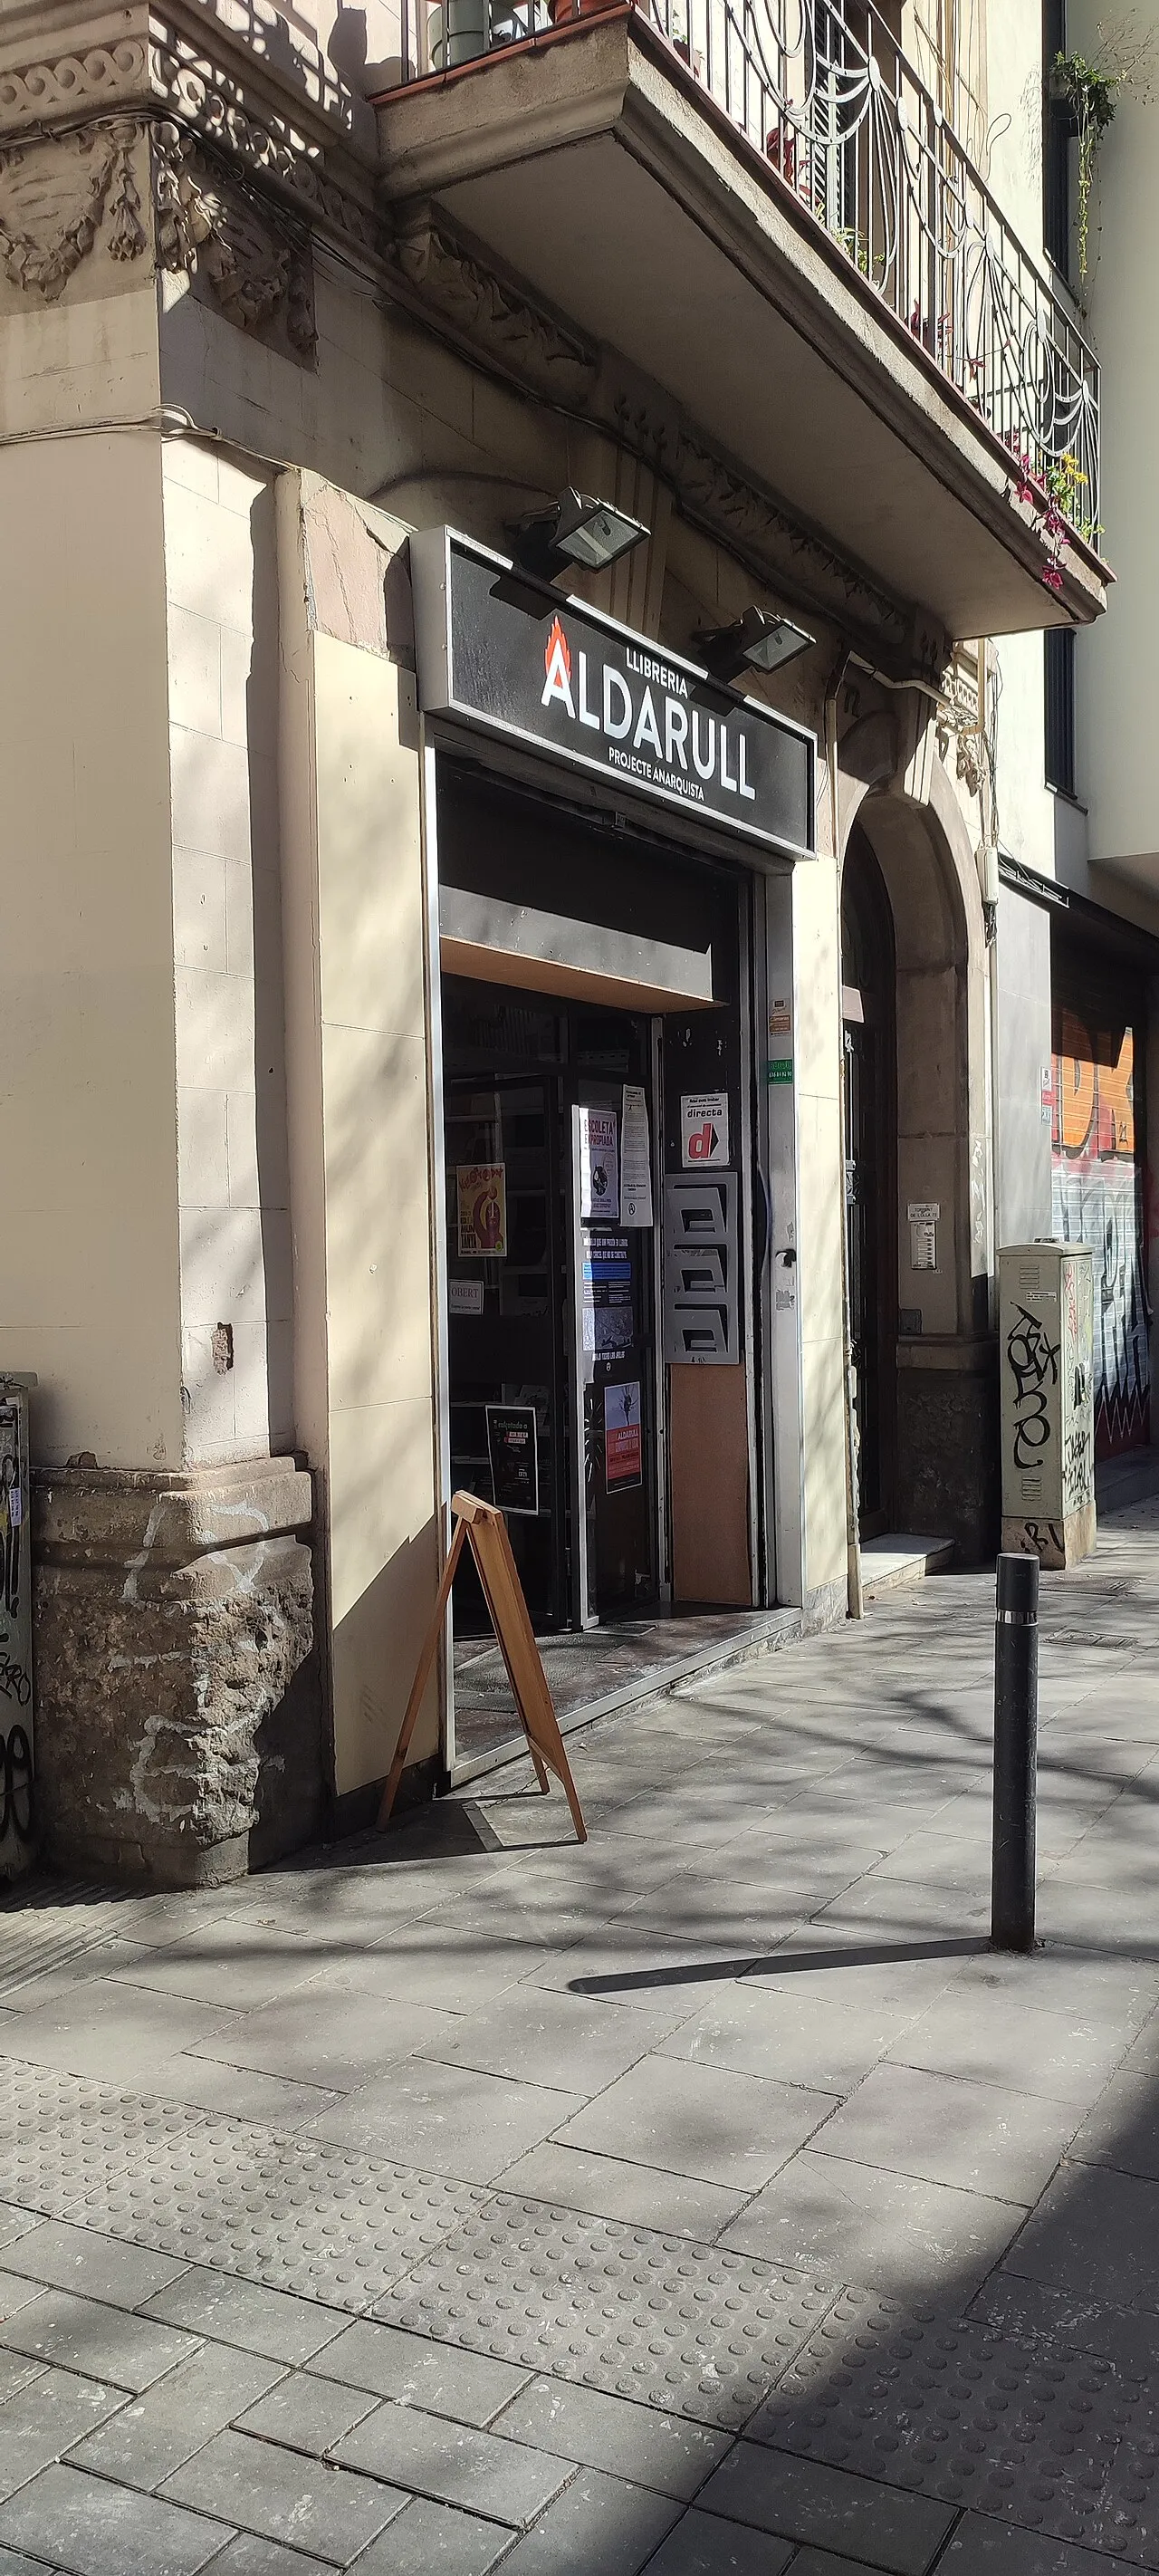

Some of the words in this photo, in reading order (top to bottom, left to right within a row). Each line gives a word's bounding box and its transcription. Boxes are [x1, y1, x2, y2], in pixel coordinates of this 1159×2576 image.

[626, 647, 688, 699] LLIBRERIA
[541, 638, 755, 801] ALDARULL
[608, 746, 652, 779] PROJECTE
[652, 769, 704, 802] ANARQUISTA
[687, 1110, 723, 1118] directa
[451, 1287, 478, 1298] OBERT
